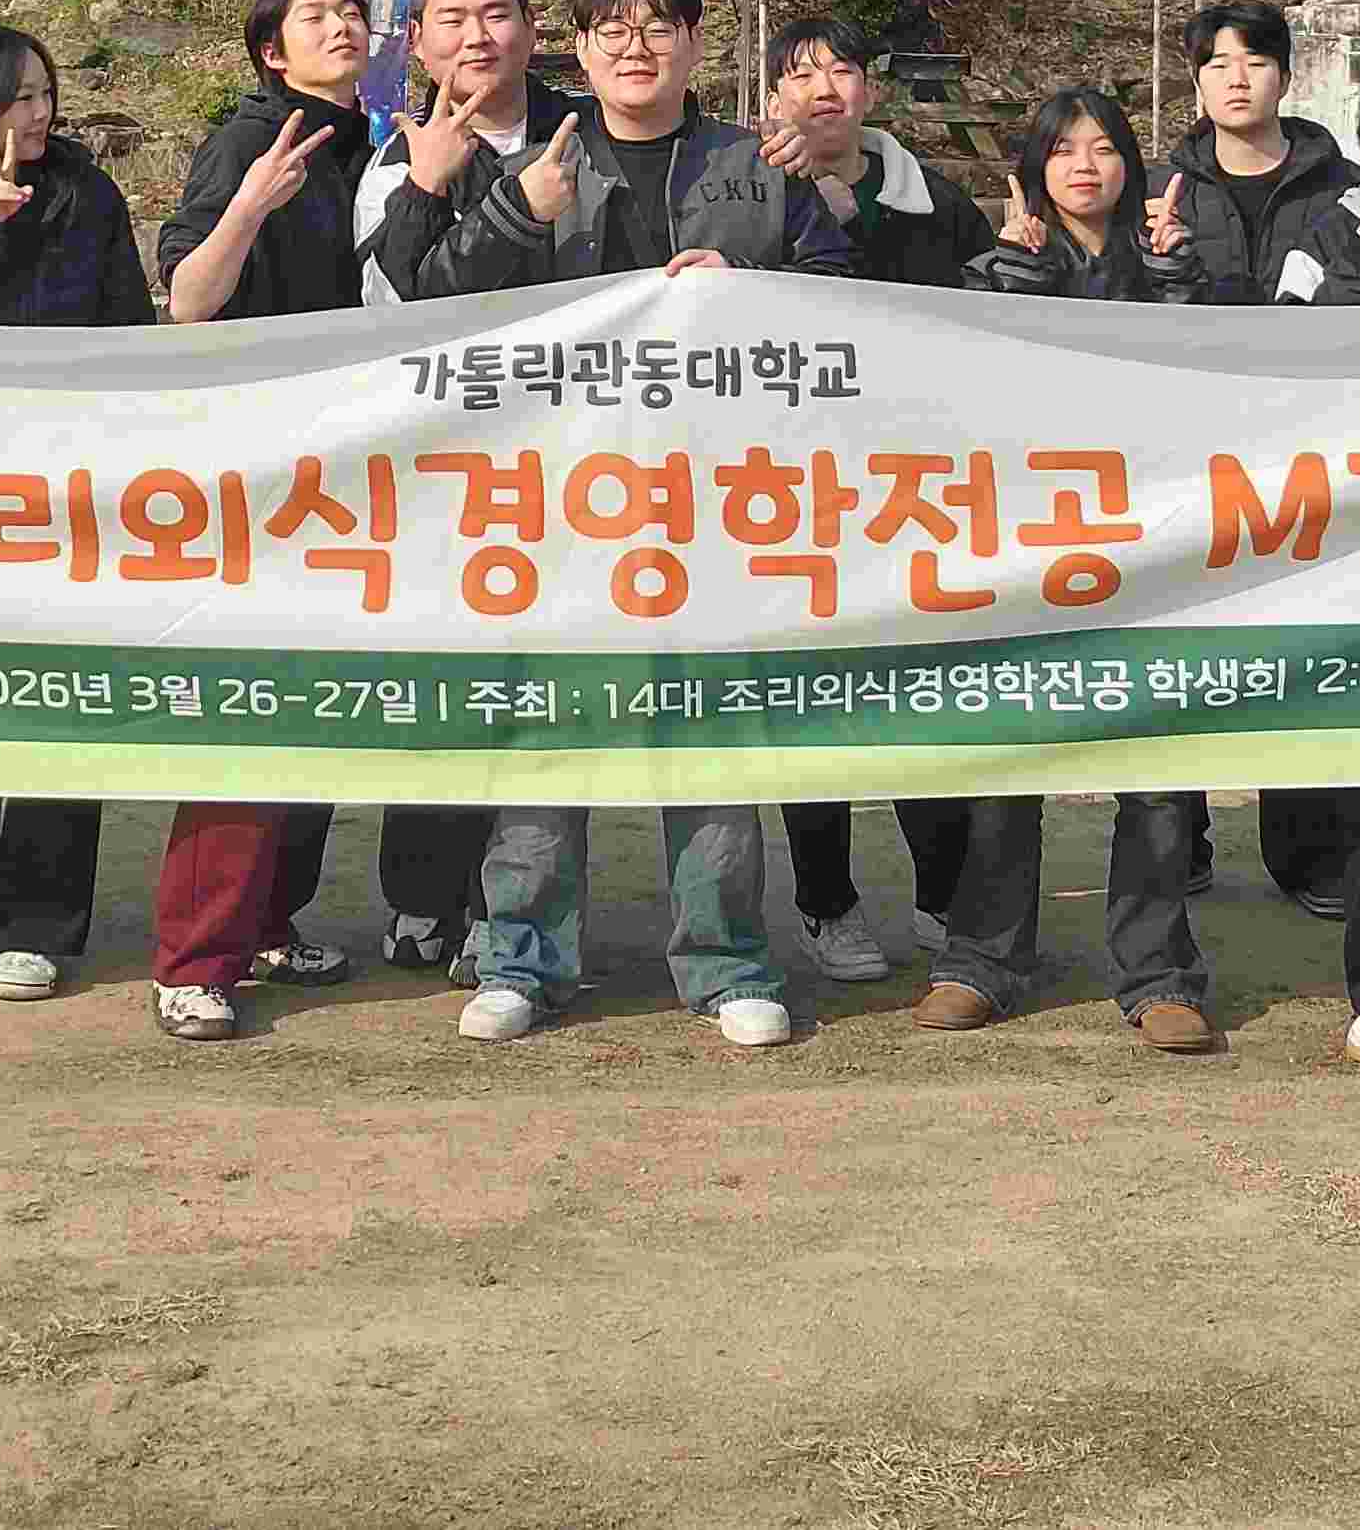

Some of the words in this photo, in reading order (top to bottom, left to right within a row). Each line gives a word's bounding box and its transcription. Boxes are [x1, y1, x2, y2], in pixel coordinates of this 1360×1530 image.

[700, 177, 769, 203] CKU
[400, 339, 861, 411] 가톨릭관동대학교
[130, 673, 203, 719] 3월
[218, 677, 417, 724] 26-27일
[465, 680, 559, 724] 주최
[603, 679, 703, 720] 14대
[718, 660, 1135, 717] 조리외식경영학전공
[1145, 657, 1288, 710] 학생회
